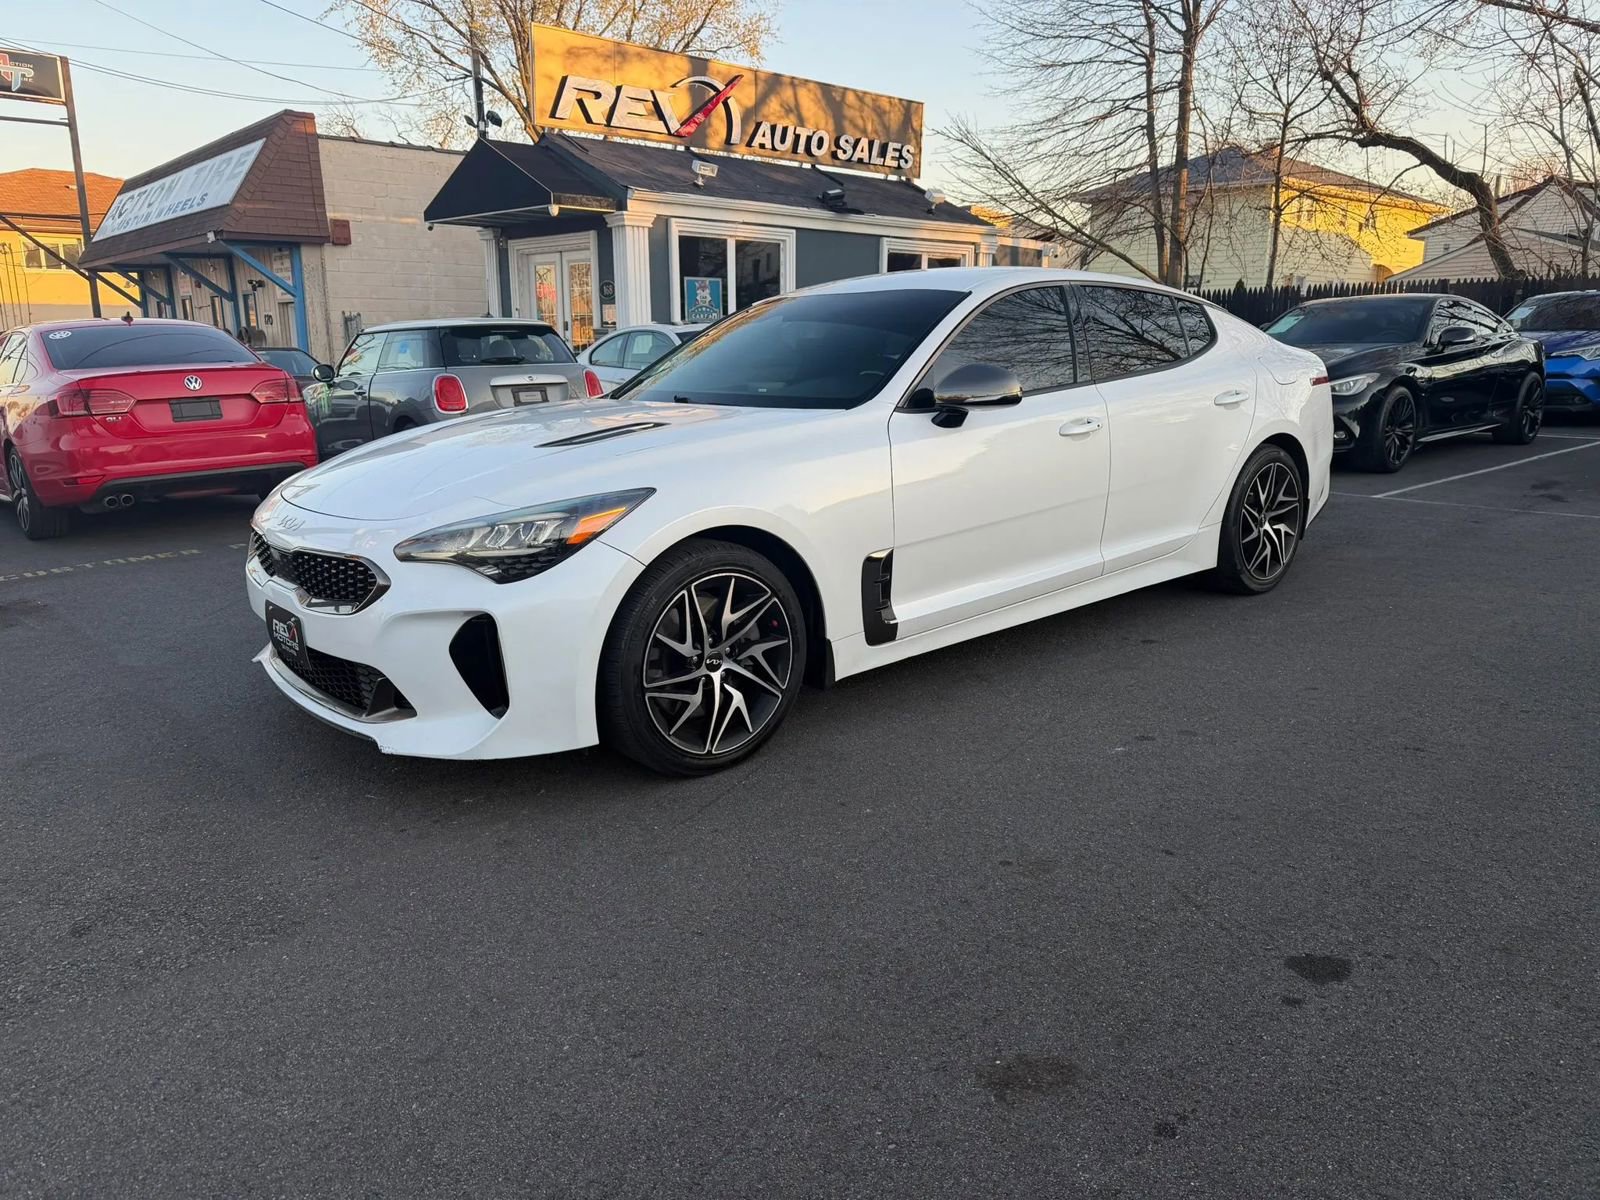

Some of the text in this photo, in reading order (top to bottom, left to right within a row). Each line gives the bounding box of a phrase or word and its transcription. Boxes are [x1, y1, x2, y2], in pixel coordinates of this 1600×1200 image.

[550, 75, 744, 138] REV
[747, 121, 915, 169] AUTO SALES
[109, 149, 254, 220] ACTION TIRE
[273, 631, 300, 651] MOTORS
